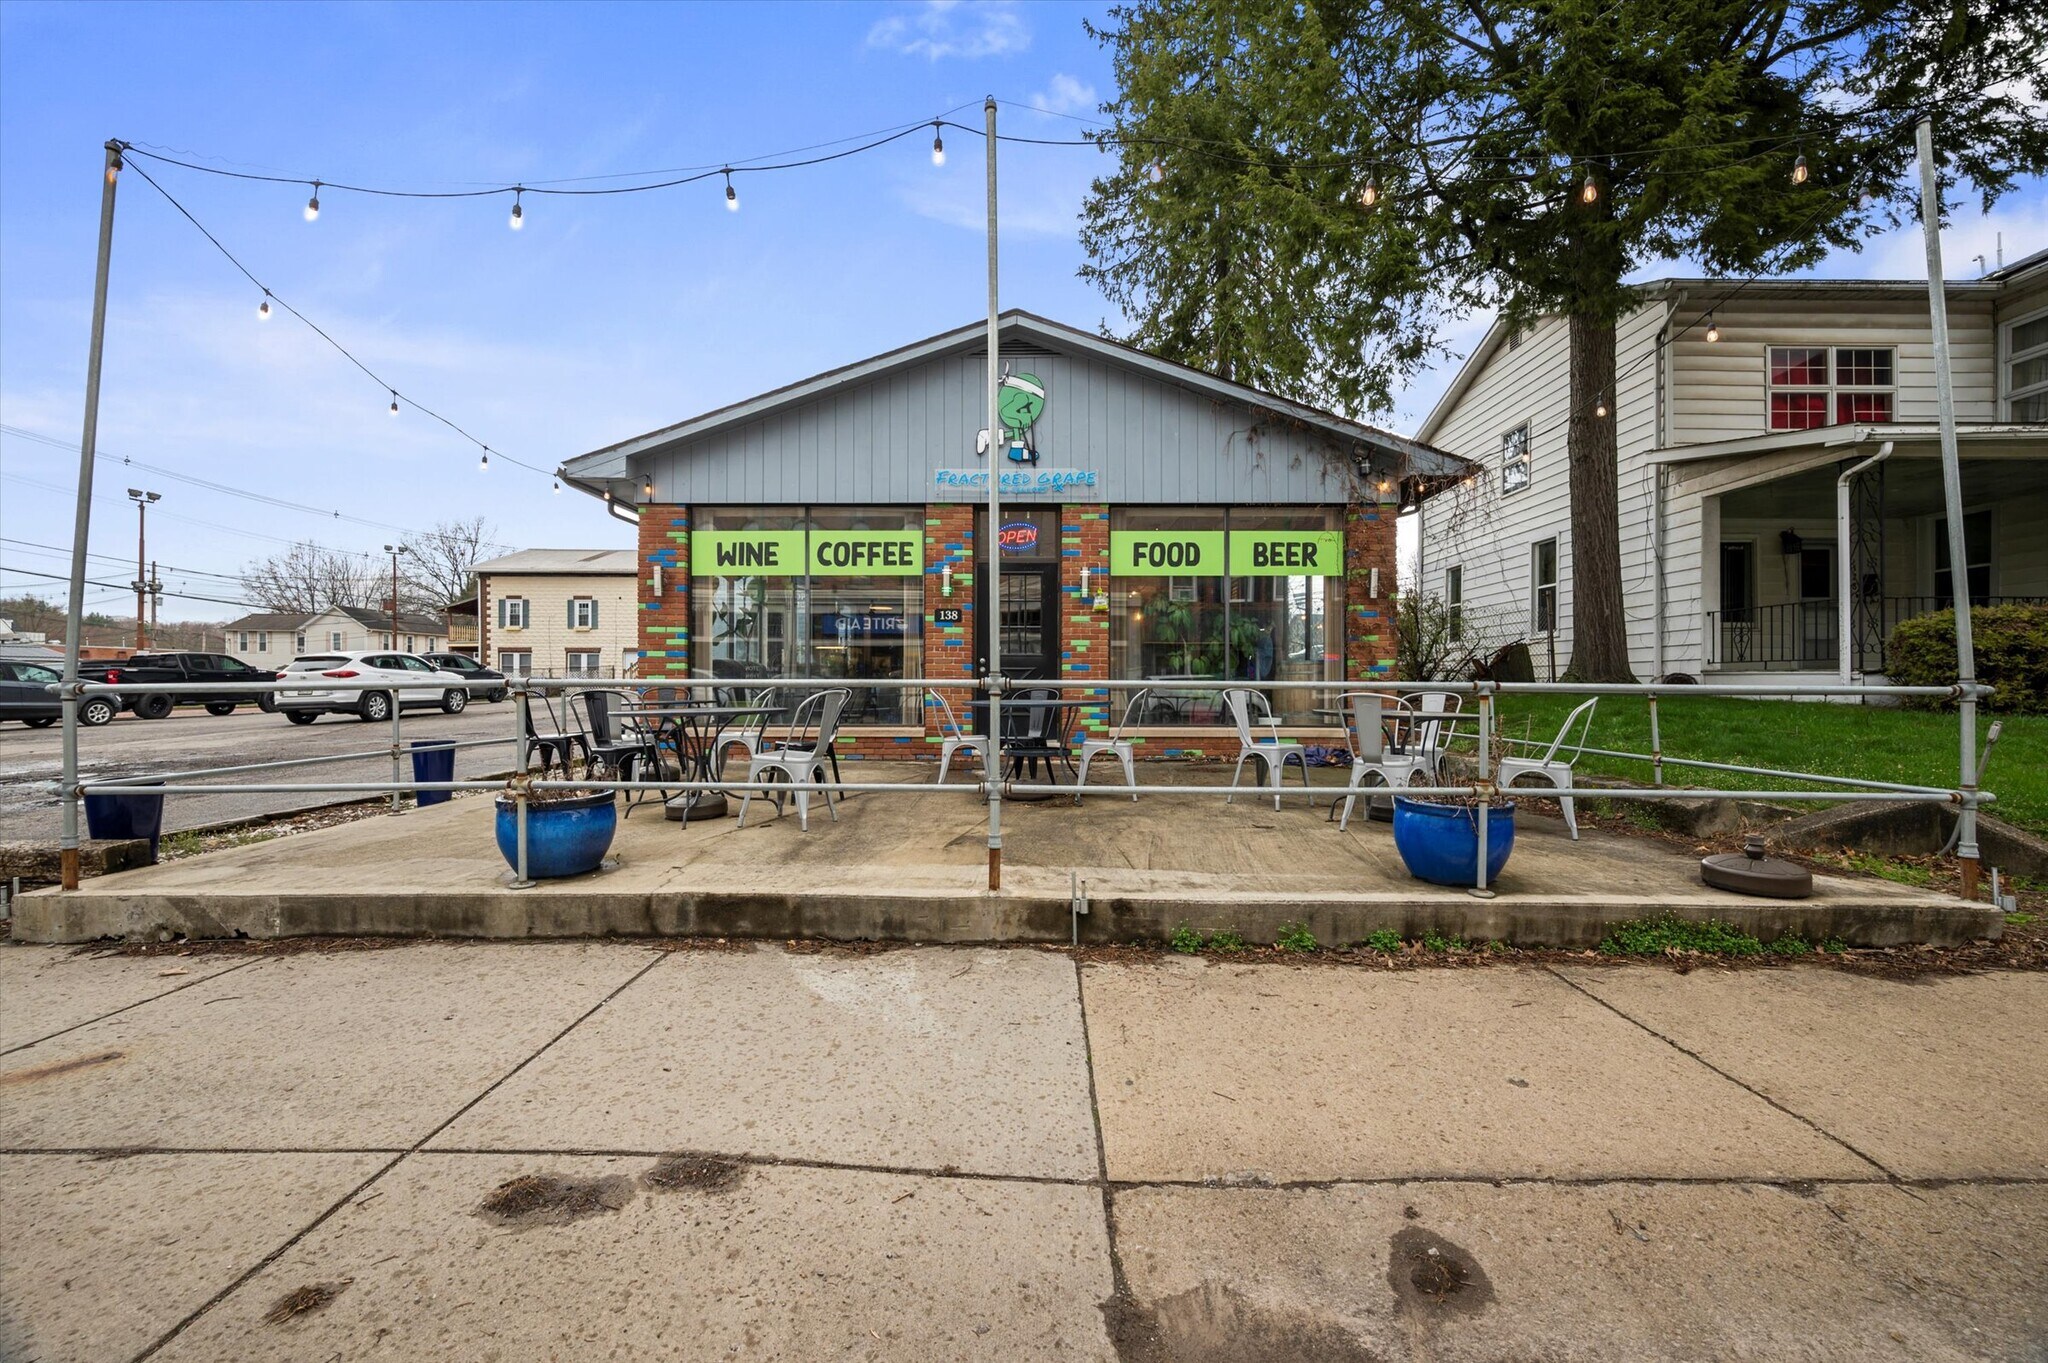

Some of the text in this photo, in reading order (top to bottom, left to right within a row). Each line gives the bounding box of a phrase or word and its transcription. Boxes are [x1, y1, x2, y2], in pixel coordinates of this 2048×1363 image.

[936, 470, 1097, 491] FRACTRED GRAPE
[998, 528, 1038, 544] OPEN
[716, 541, 779, 567] WINE
[817, 541, 914, 567] COFFEE
[1133, 542, 1200, 567] FOOD
[1253, 542, 1318, 567] BEER
[939, 610, 958, 620] 138
